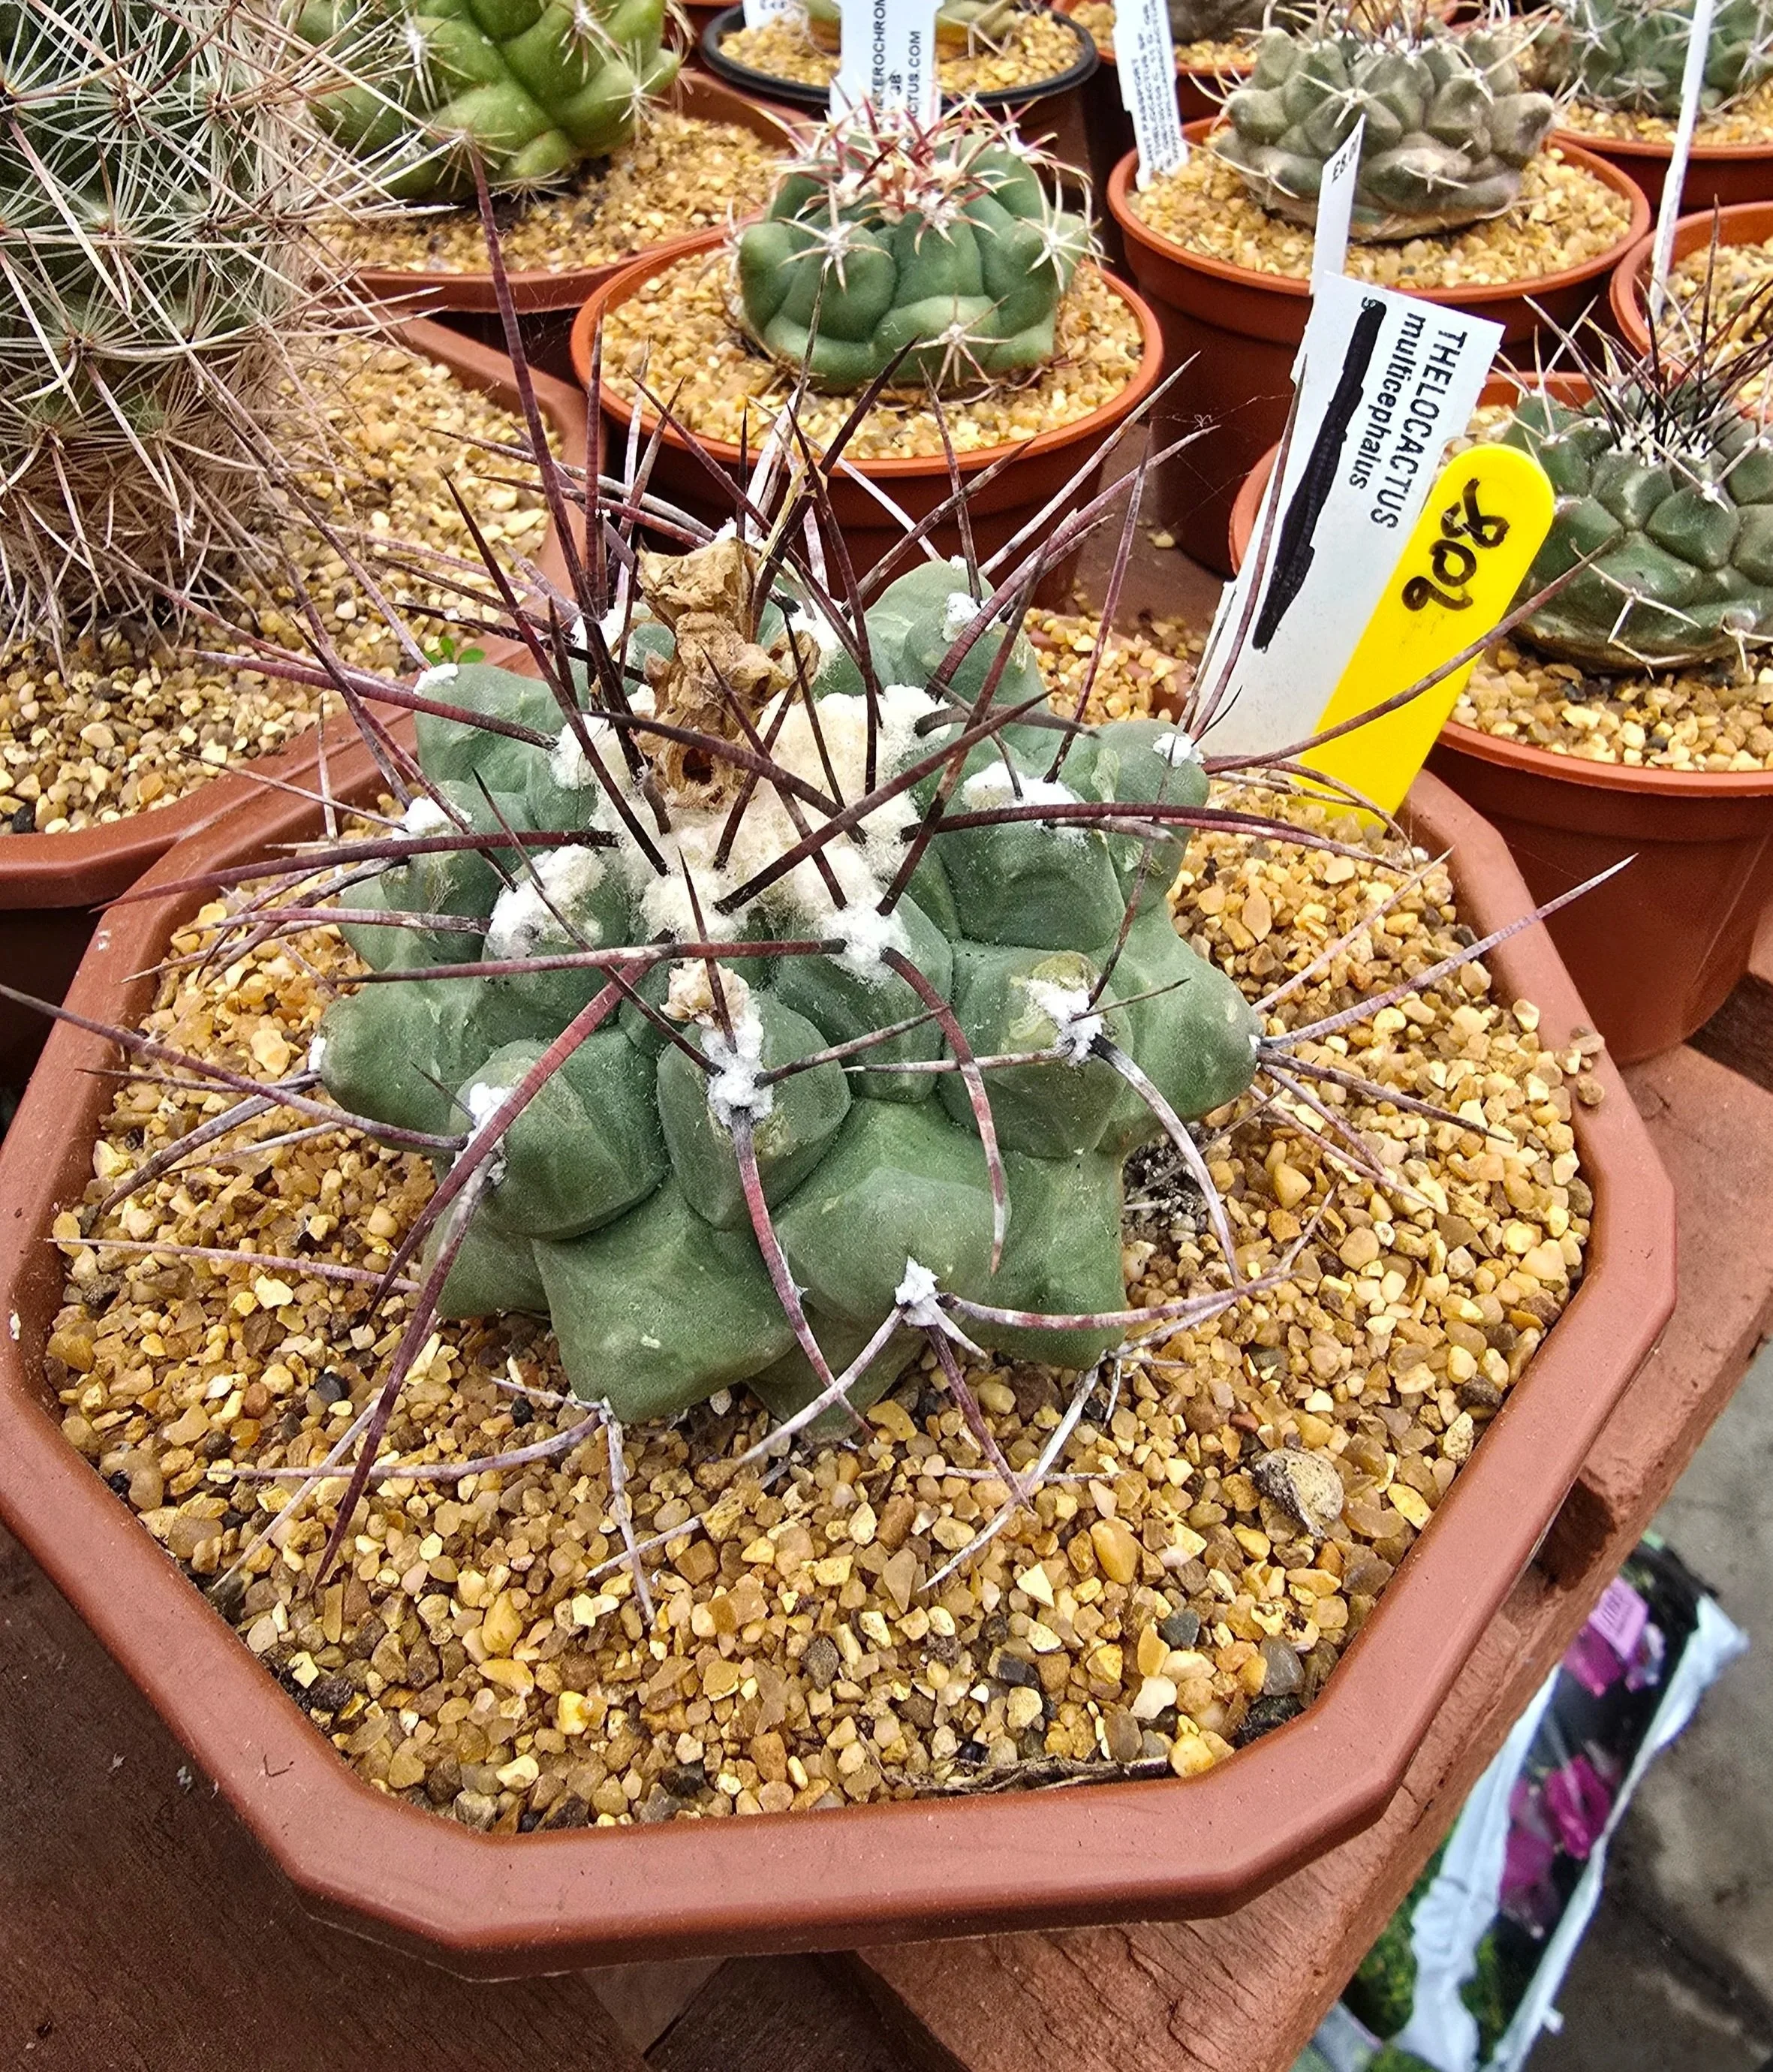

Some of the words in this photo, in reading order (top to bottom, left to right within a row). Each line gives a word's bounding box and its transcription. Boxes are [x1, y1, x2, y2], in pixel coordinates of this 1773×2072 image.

[1349, 312, 1427, 490] multicephalus
[1371, 330, 1467, 529] THELOCACTUS
[1401, 477, 1510, 612] 806
